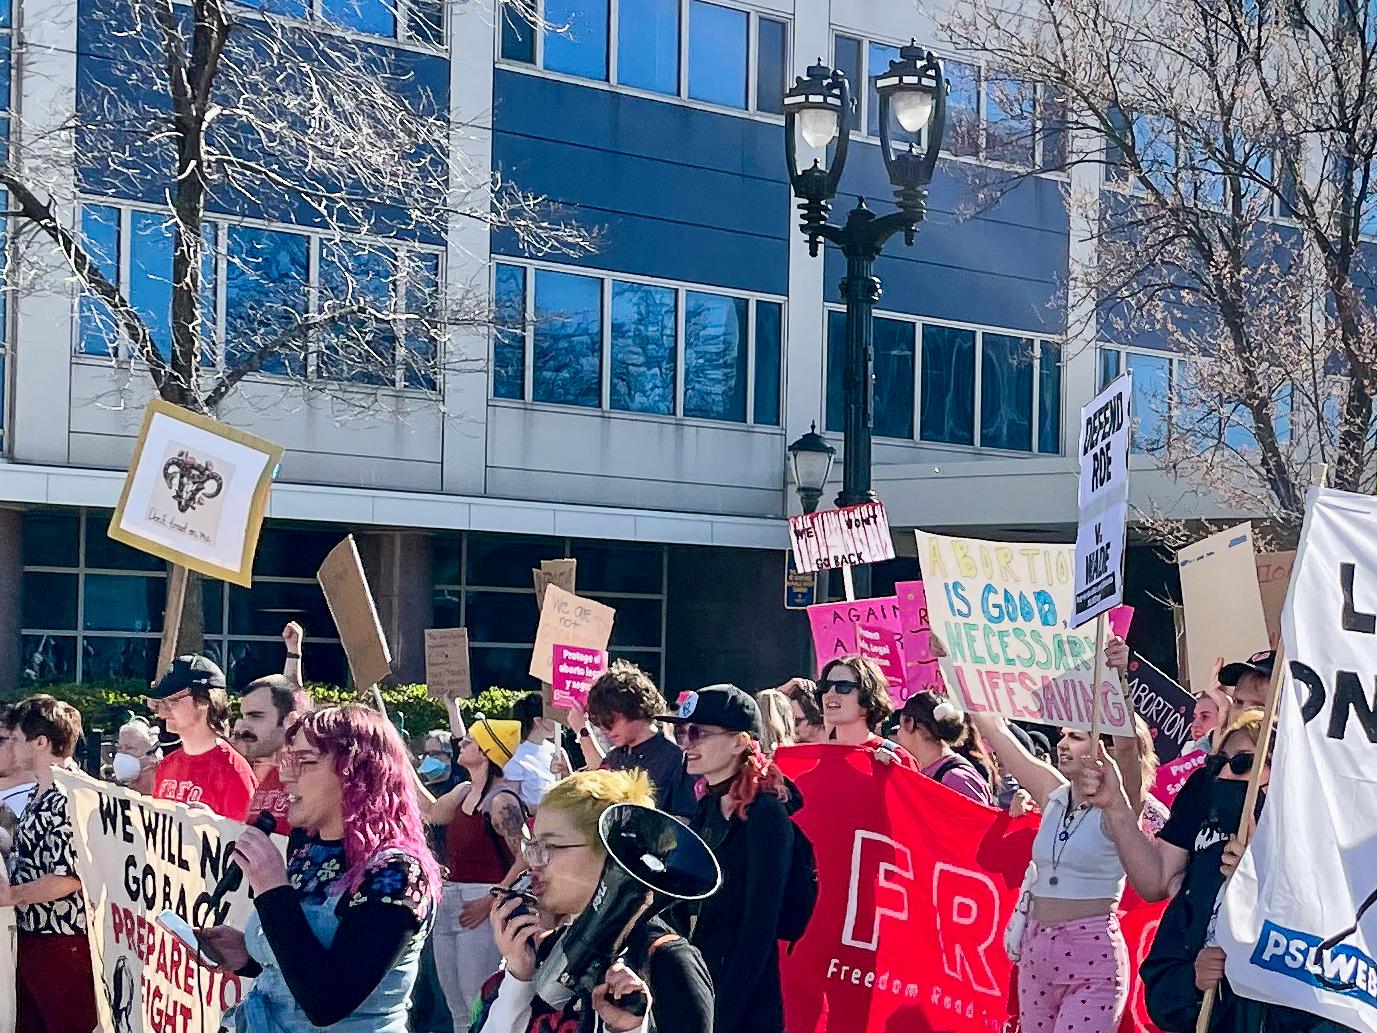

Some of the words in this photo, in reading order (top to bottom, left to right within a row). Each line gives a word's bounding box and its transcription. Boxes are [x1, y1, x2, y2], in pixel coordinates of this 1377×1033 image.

[1083, 391, 1124, 456] DEFEND
[1091, 440, 1112, 492] ROE
[794, 526, 814, 541] WE
[815, 557, 830, 570] GO
[833, 552, 866, 567] BACK
[1085, 541, 1112, 586] WADE
[943, 580, 973, 619] IS
[1128, 677, 1193, 746] ABORTION
[98, 791, 135, 844] WE
[138, 804, 191, 873] WILL
[124, 854, 157, 912] GO
[111, 902, 195, 998] PREPARE
[826, 958, 919, 999] Freedom
[930, 985, 975, 1019] Road
